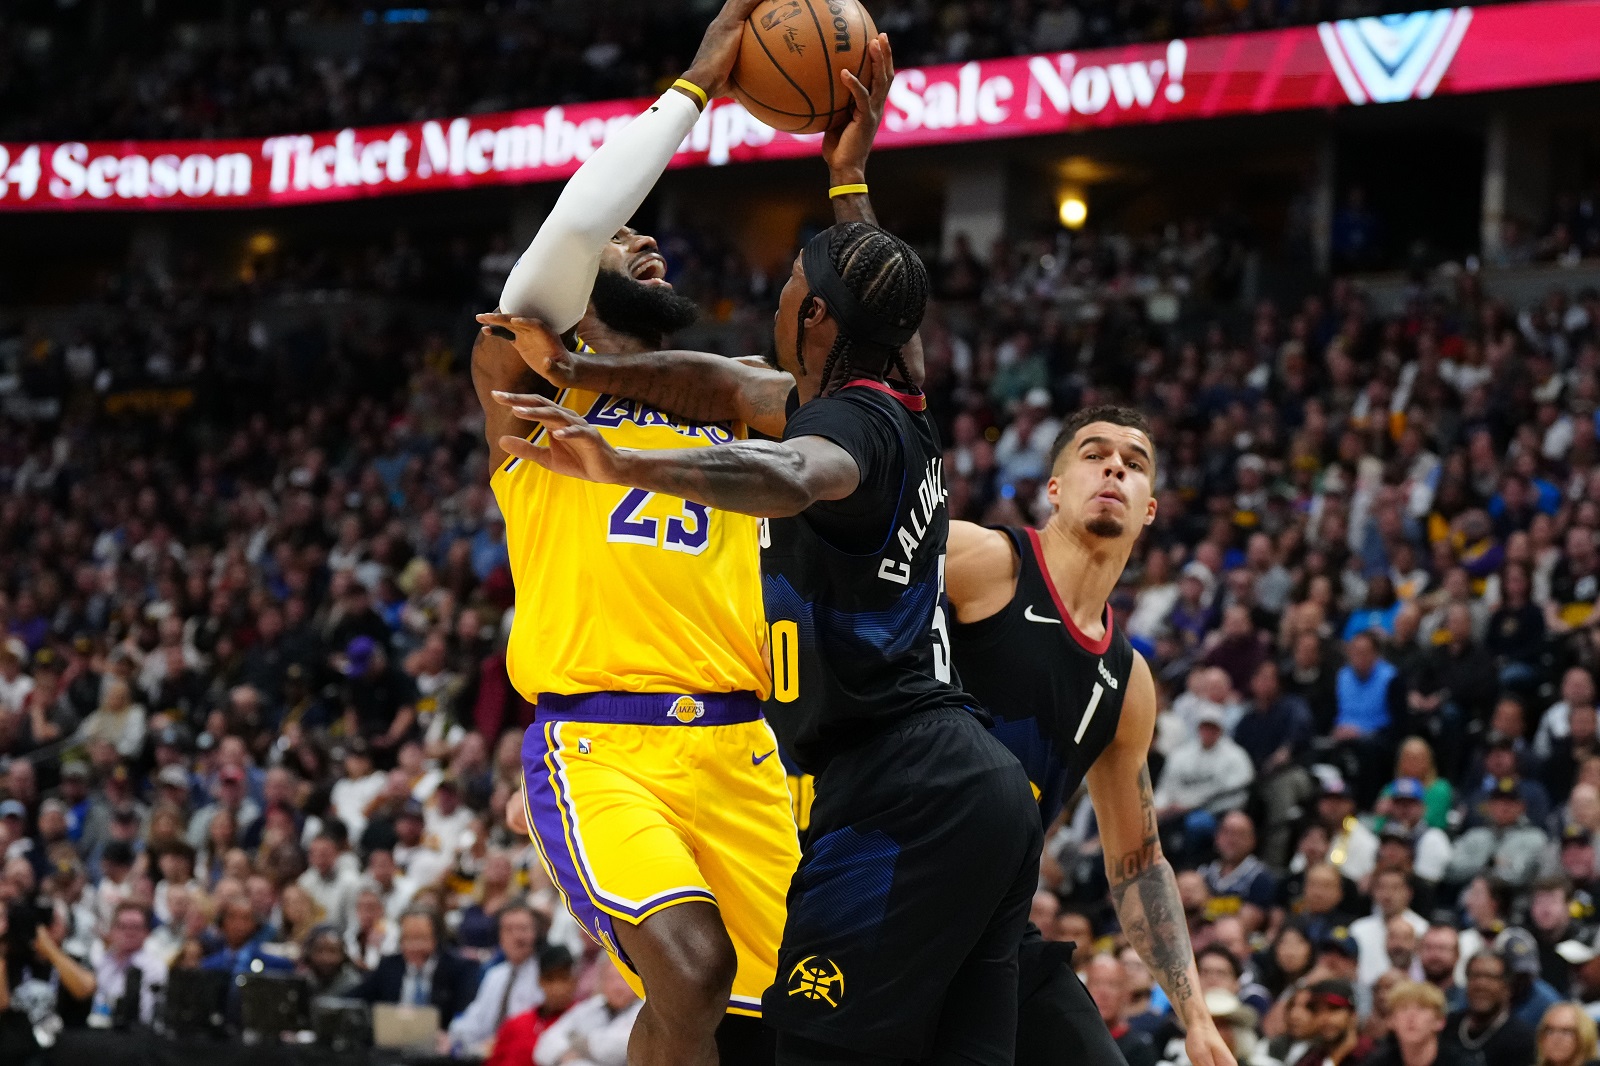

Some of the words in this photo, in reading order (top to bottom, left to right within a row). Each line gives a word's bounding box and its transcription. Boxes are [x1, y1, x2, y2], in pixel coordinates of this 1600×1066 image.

[49, 142, 252, 199] Season
[262, 128, 411, 192] Ticket
[885, 61, 1014, 133] Sale
[1025, 39, 1187, 119] Now!
[607, 487, 712, 556] 23
[1073, 681, 1104, 745] 1
